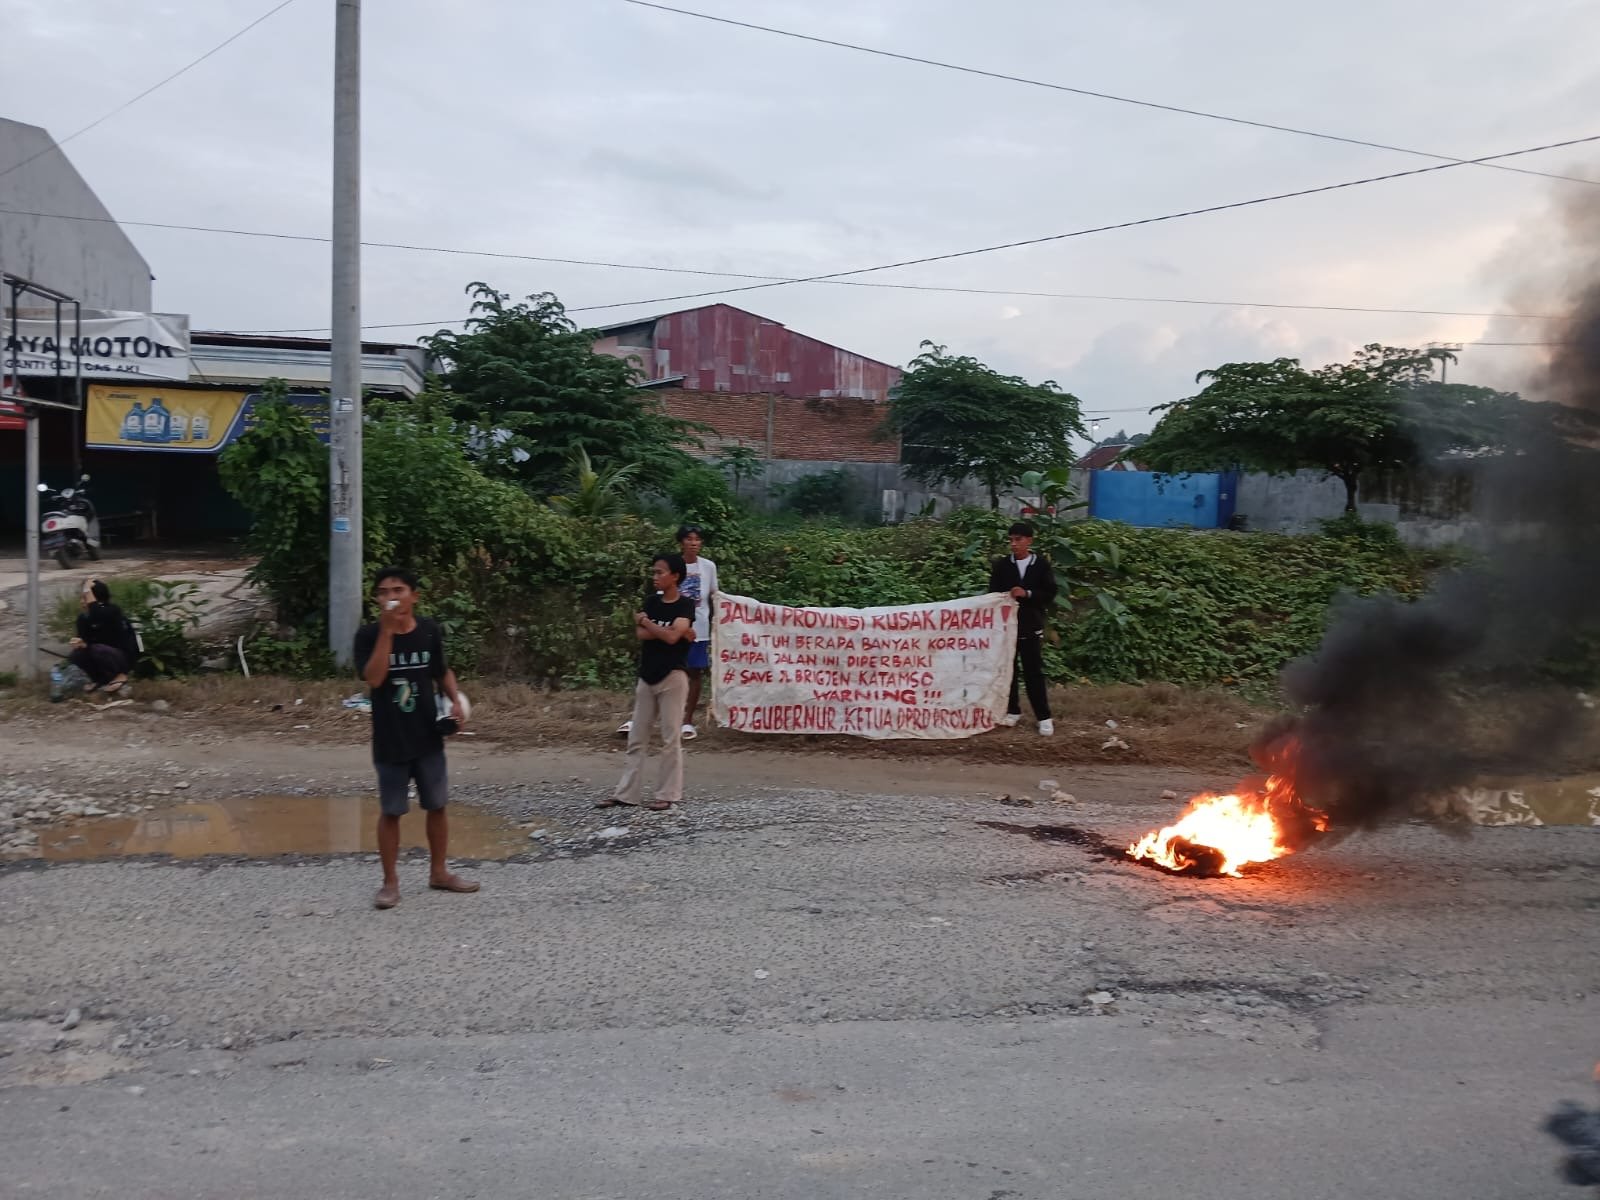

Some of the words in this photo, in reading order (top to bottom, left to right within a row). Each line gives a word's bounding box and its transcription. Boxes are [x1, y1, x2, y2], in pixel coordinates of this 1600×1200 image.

[69, 336, 175, 358] MOTOR
[720, 602, 776, 625] JALAN
[782, 607, 865, 631] PROVINSI
[871, 610, 936, 631] RUSAK
[940, 606, 994, 631] PARAH
[741, 633, 789, 649] BUTUH
[795, 636, 855, 650] BERAPA
[862, 637, 920, 651] BANYAK
[927, 637, 990, 651] KORBAN
[720, 649, 768, 663] SAMPAI
[774, 653, 816, 665] JALAN
[823, 654, 840, 666] INI
[847, 654, 933, 668] DIPERBAIKI
[740, 669, 773, 684] SAVE
[795, 670, 850, 686] BRIGJEN
[858, 671, 935, 688] KATAMSO
[813, 689, 917, 705] WARNING
